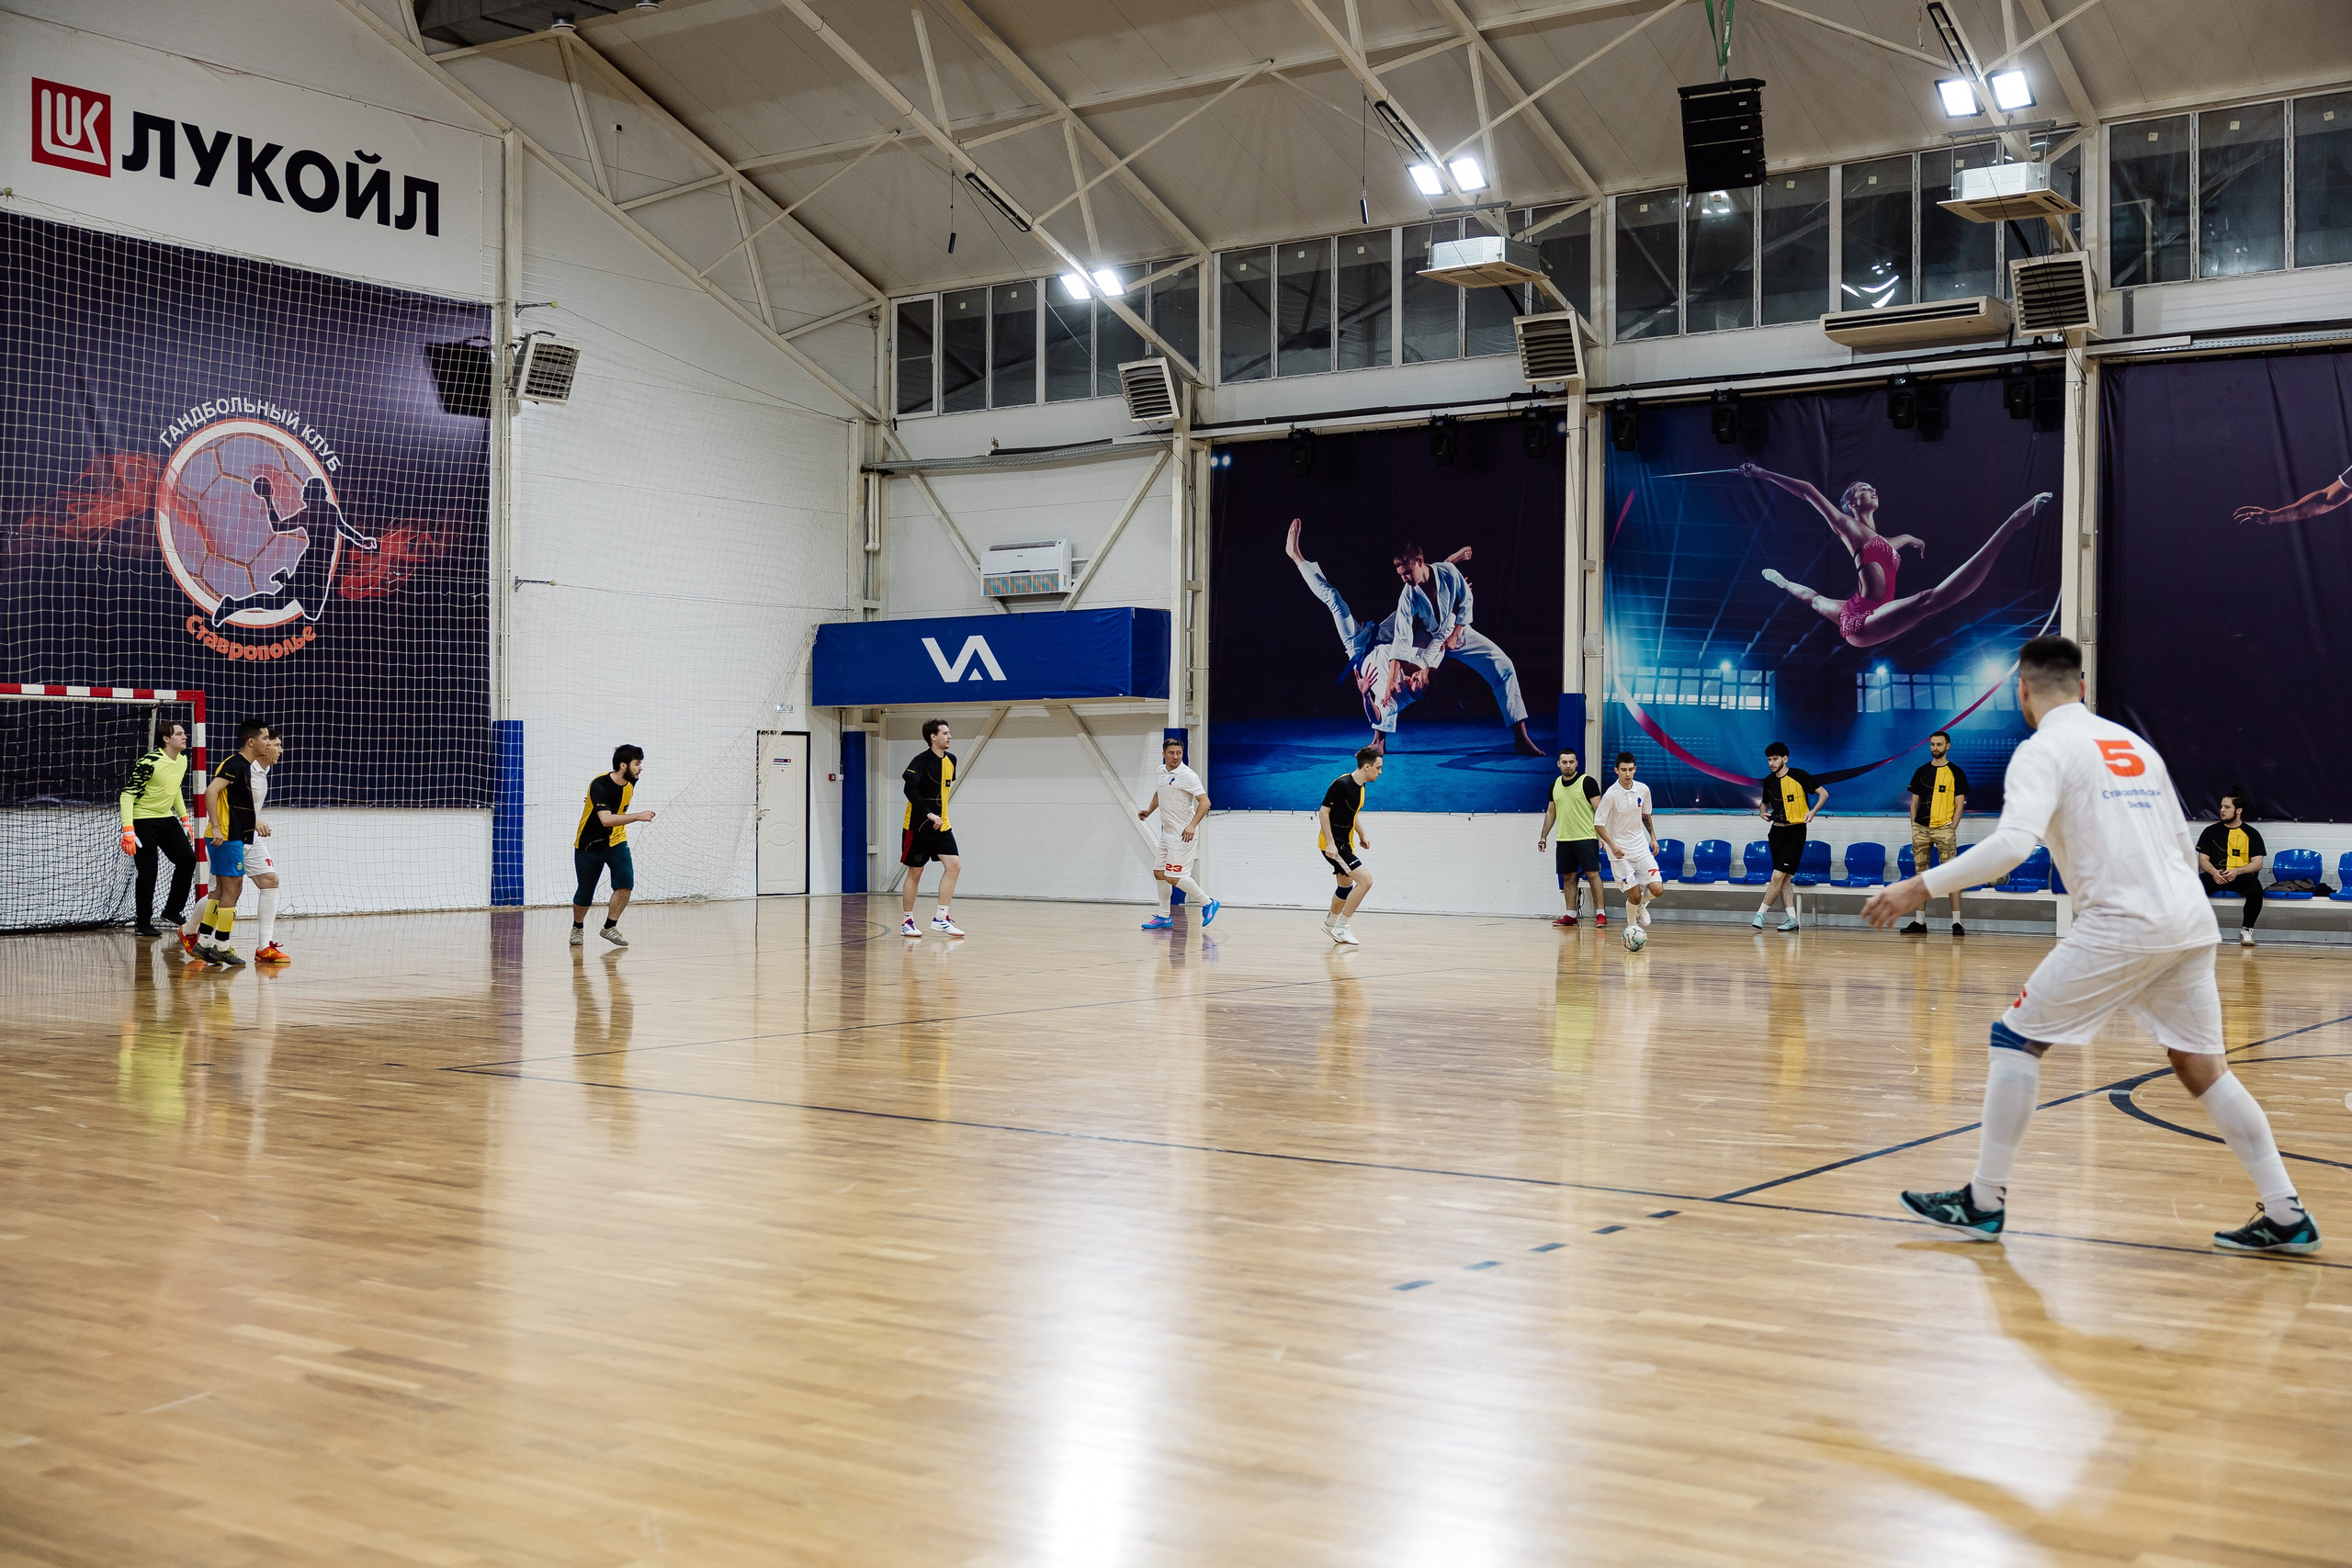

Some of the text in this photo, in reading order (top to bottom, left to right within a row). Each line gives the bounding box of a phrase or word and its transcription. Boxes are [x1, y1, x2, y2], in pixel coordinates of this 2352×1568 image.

[122, 111, 439, 237] ЛУКОЙЛ
[159, 397, 342, 472] ГАНДБОЛЬНЫЙ КЛУБ
[186, 615, 317, 661] Ставрополье
[2094, 739, 2146, 777] 5
[1165, 863, 1183, 873] 23
